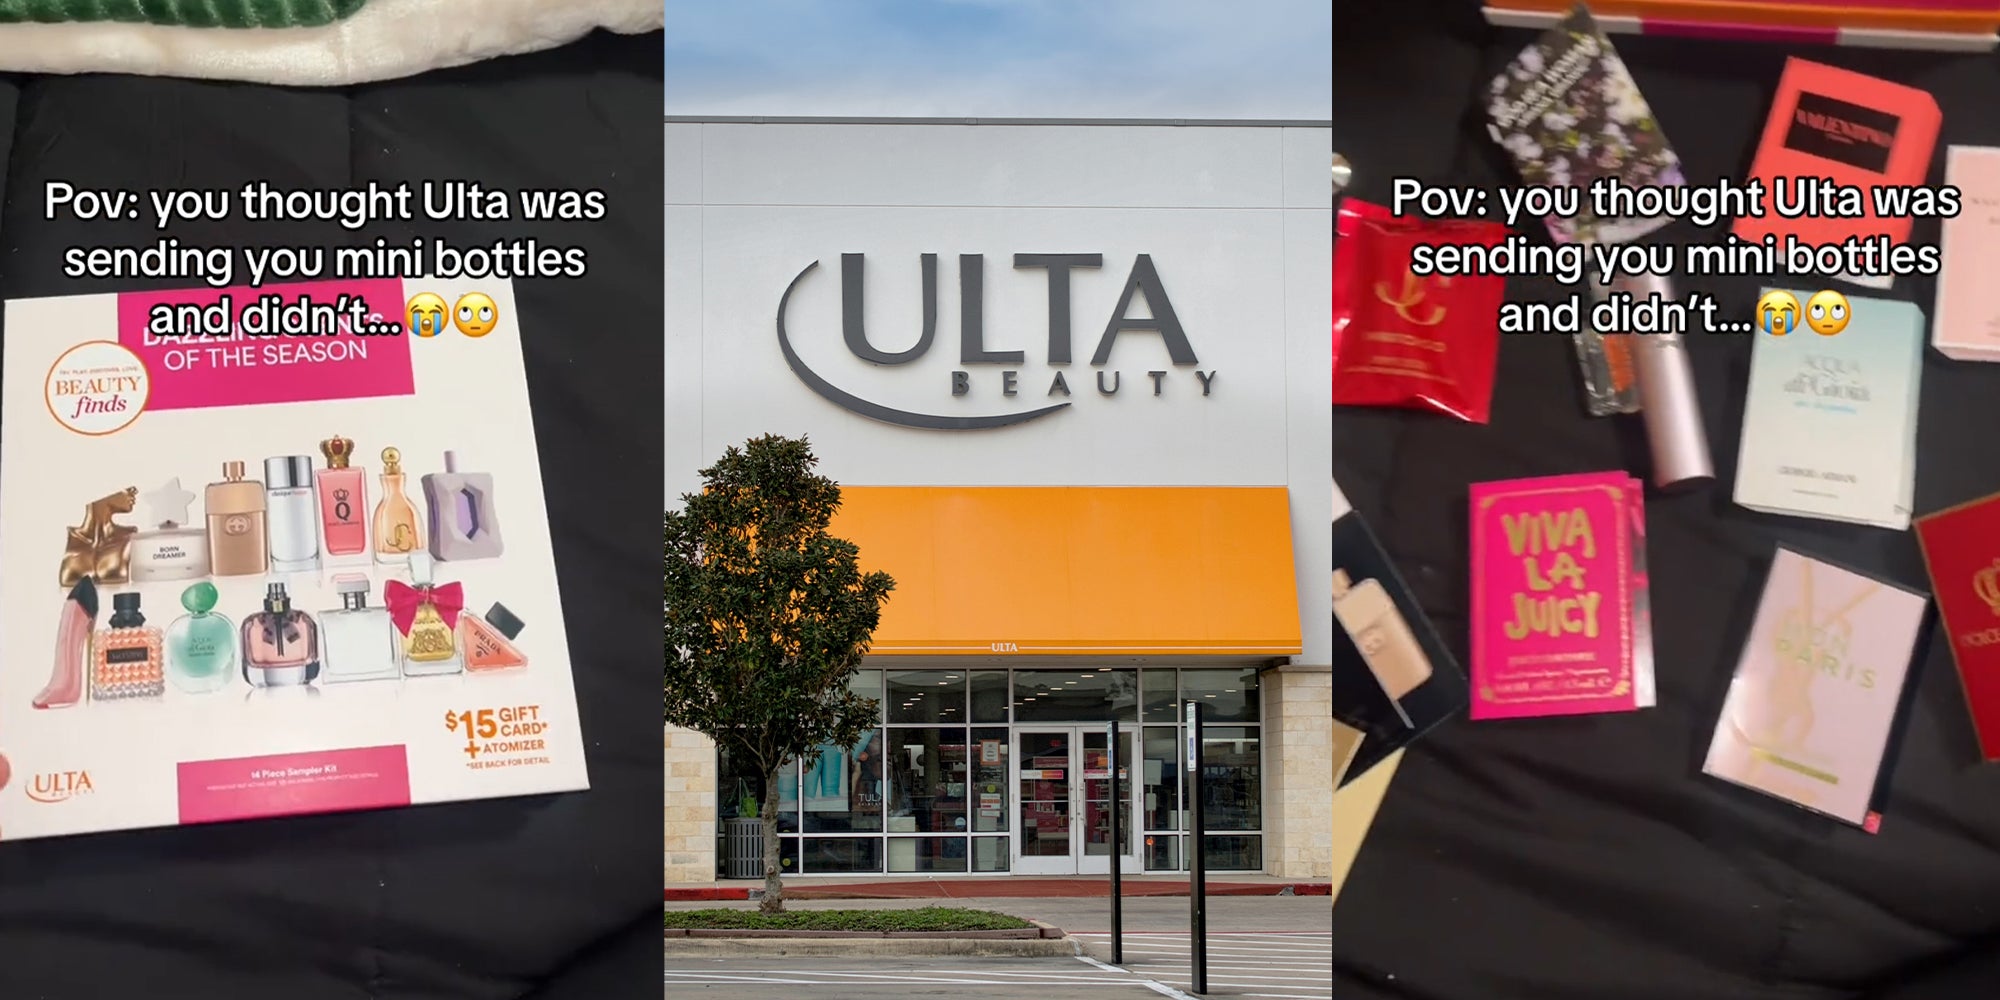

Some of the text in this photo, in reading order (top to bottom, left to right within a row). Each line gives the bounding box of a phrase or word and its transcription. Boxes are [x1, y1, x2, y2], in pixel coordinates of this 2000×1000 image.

[841, 253, 1199, 366] ULTA
[164, 339, 368, 371] OF THE SEASON
[55, 375, 142, 396] BEAUTY
[951, 370, 1217, 397] BEAUTY
[70, 394, 128, 420] finds
[335, 501, 351, 521] Q
[1502, 507, 1597, 559] VIVA
[152, 551, 187, 560] DREAMER
[1523, 551, 1587, 592] LA
[1503, 590, 1602, 641] JUICY
[474, 629, 502, 655] PRADA
[991, 642, 1018, 653] ULTA
[1776, 638, 1877, 689] PARIS
[445, 708, 498, 739] $15
[498, 705, 540, 723] GIFT
[483, 739, 546, 754] ATOMIZER
[262, 770, 286, 778] Piece
[287, 767, 323, 777] Sampler
[324, 764, 337, 773] Kit
[485, 759, 507, 768] BACK
[508, 758, 523, 766] FOR
[524, 756, 551, 765] DETAIL
[35, 769, 93, 793] ULTA
